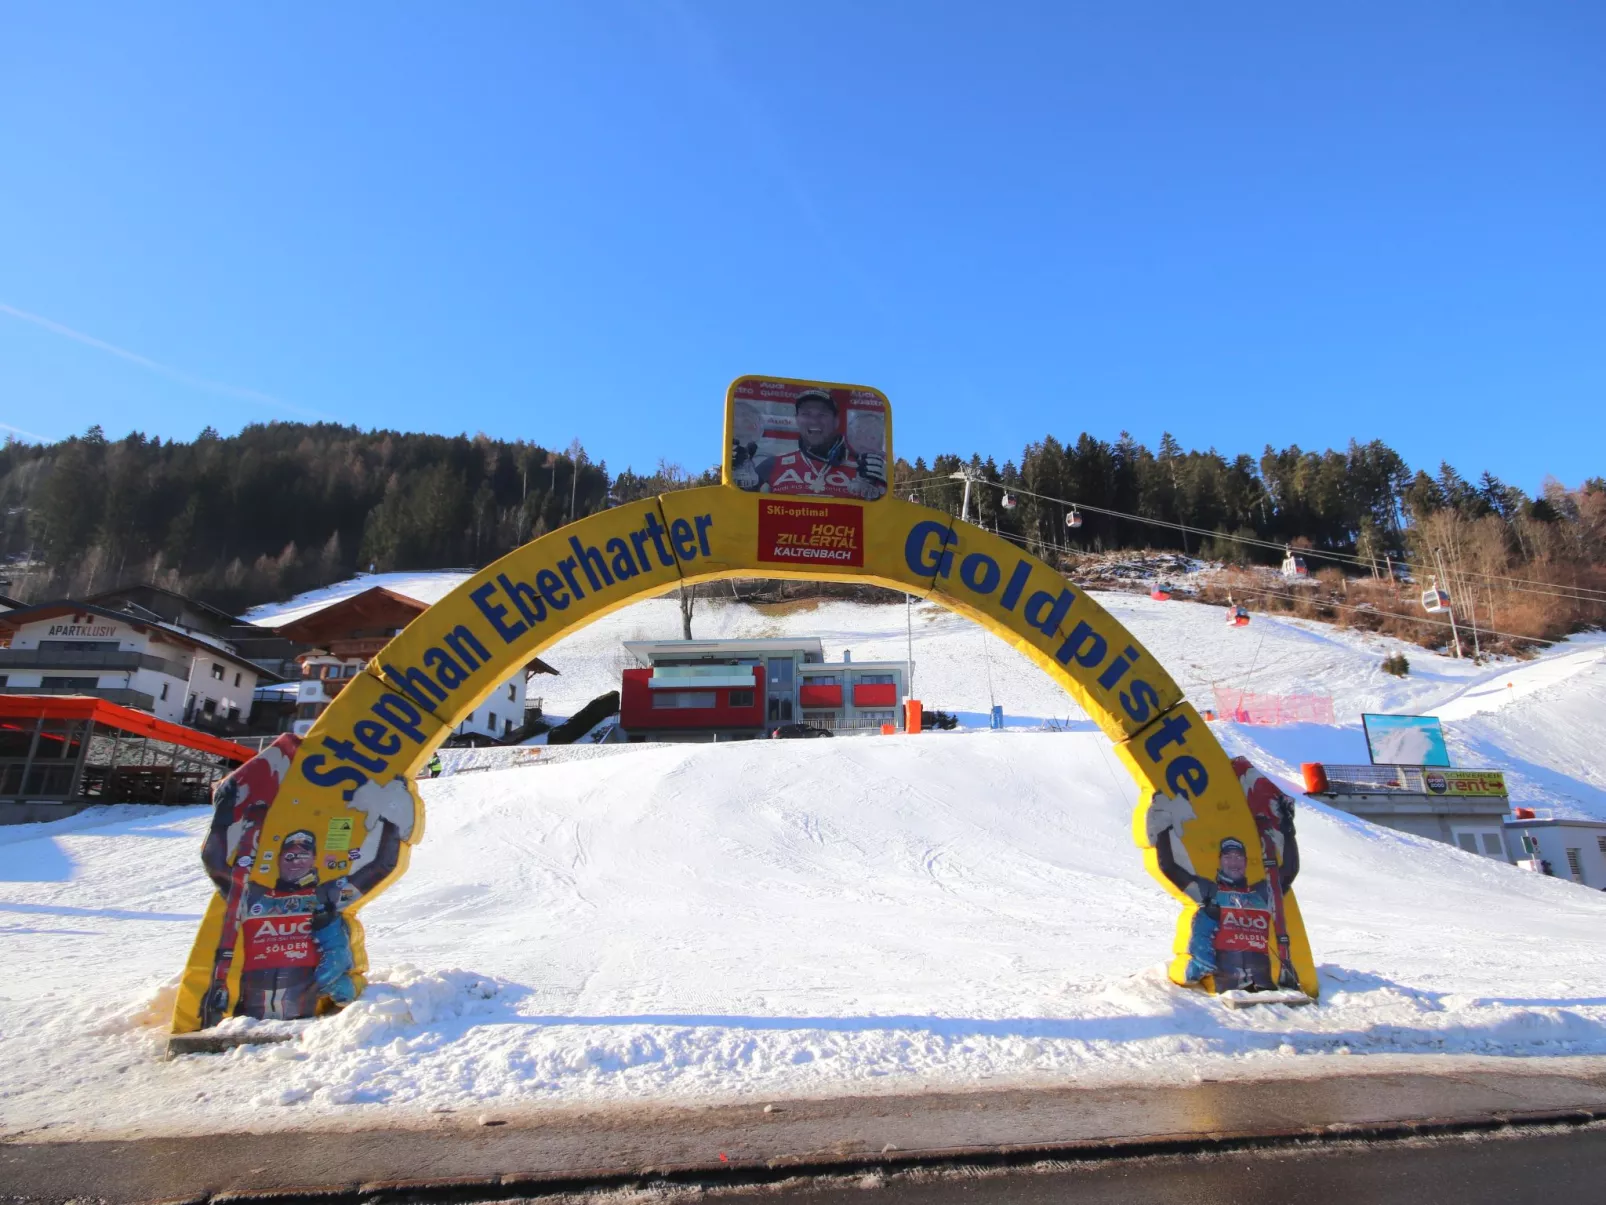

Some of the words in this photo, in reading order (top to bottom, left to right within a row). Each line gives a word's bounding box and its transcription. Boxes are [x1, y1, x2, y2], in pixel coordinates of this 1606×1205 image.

[811, 524, 855, 537] HOCH
[777, 533, 857, 549] ZILLERTAL
[774, 547, 851, 560] KALTENBACH
[302, 624, 492, 801] Stephan
[469, 511, 713, 644] Eberharter
[904, 520, 1209, 800] Goldpiste
[1447, 777, 1490, 792] rent
[265, 941, 308, 954] SÖLDEN
